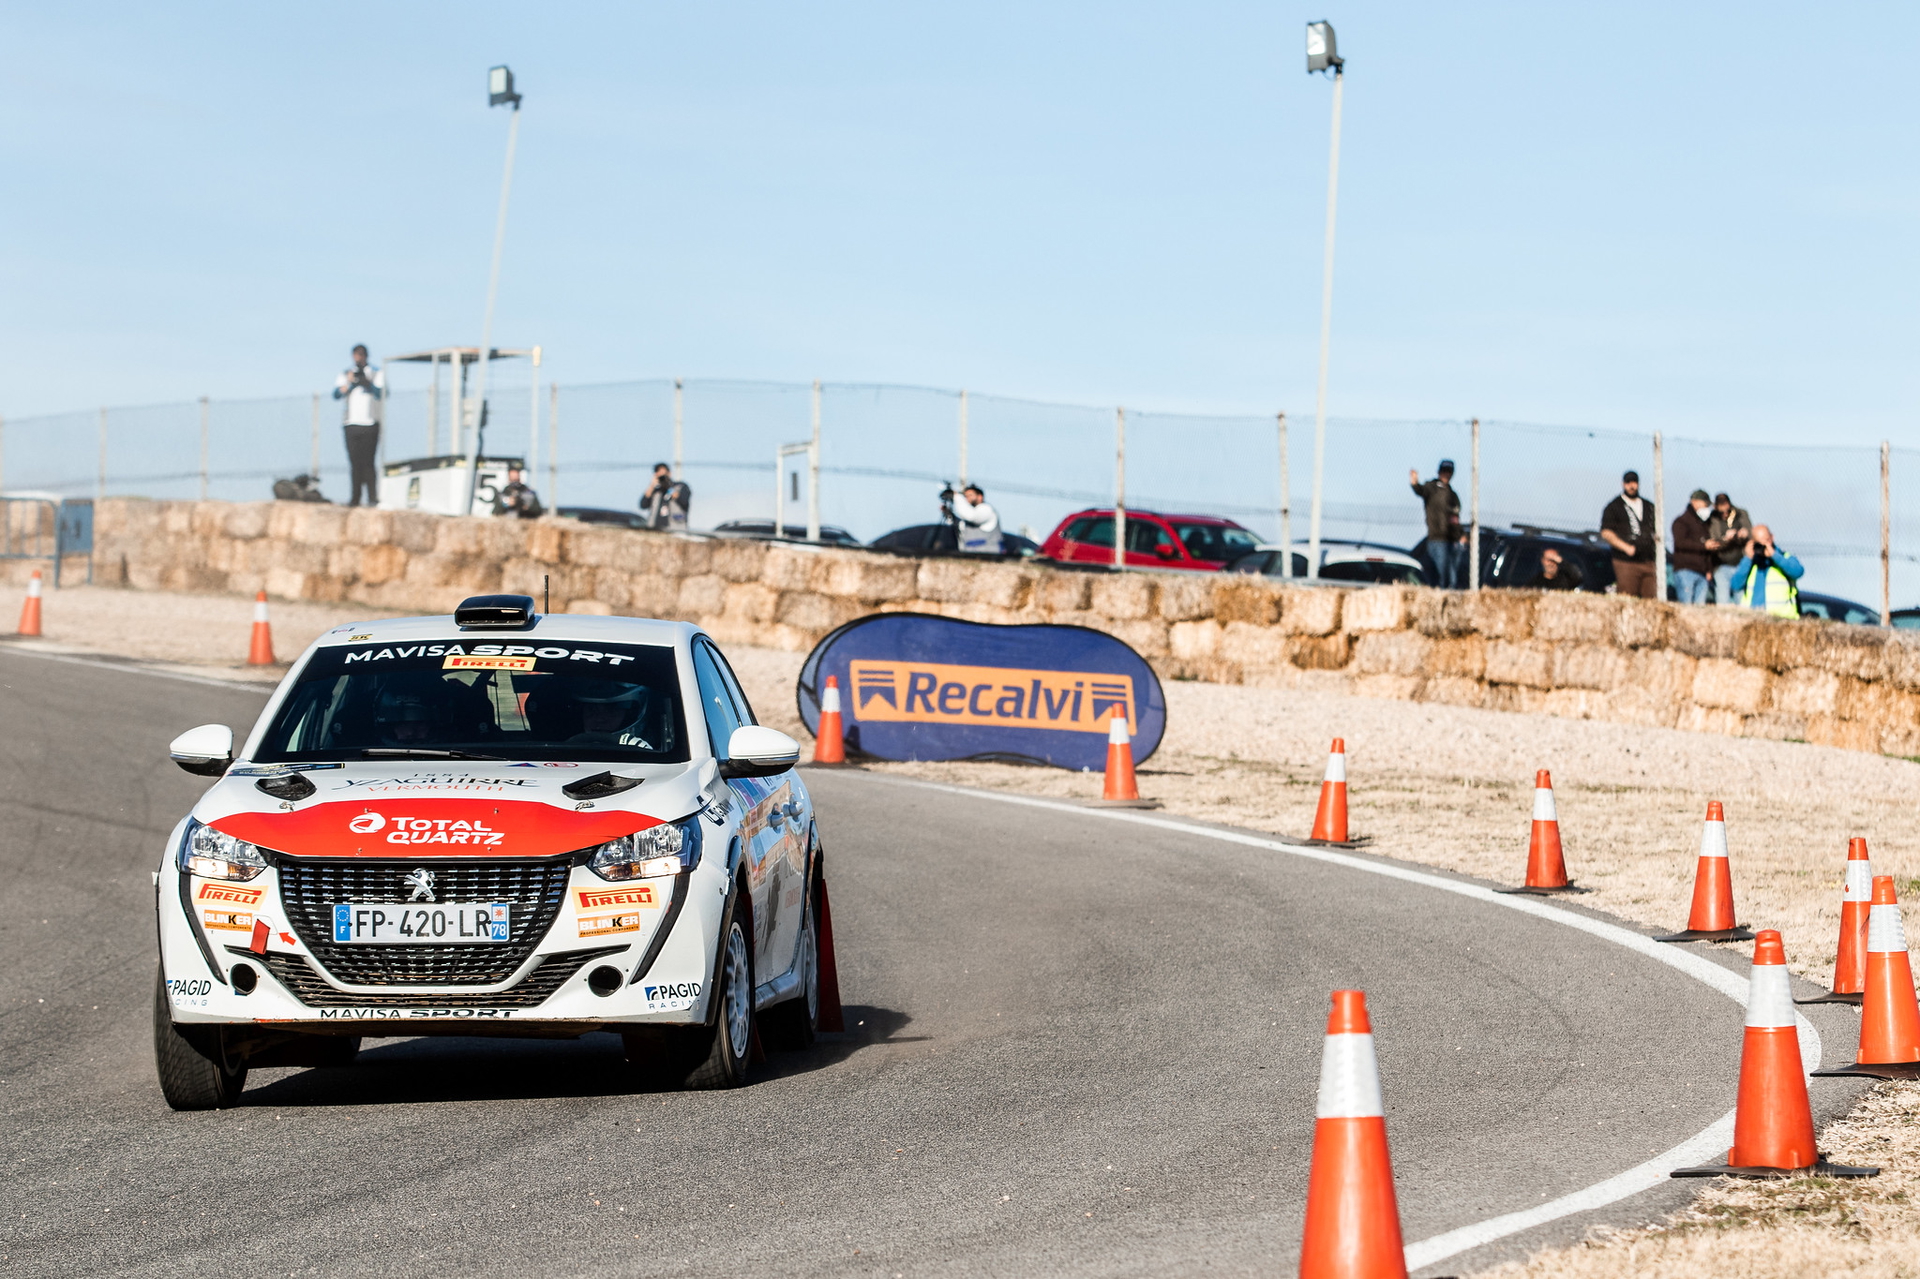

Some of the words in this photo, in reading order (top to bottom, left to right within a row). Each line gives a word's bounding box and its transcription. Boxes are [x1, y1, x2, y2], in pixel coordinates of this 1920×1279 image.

[478, 474, 498, 503] 5
[344, 644, 466, 664] MAVISA
[469, 644, 635, 666] SPORT
[452, 658, 527, 668] PIRELLI
[904, 671, 1084, 722] Recalvi
[391, 816, 492, 832] TOTAL
[386, 831, 505, 845] QUARTZ
[198, 883, 262, 905] PIRELLI
[578, 887, 653, 908] PIRELLI
[204, 912, 252, 926] BLINKER
[355, 909, 490, 938] FP-420-LR
[579, 916, 639, 930] BLINKER
[340, 925, 346, 934] F
[492, 923, 507, 937] 78
[172, 979, 212, 996] PAGID
[659, 982, 702, 1000] PAGID
[174, 998, 208, 1007] CING
[320, 1008, 401, 1020] MAVISA
[409, 1008, 519, 1019] SPORT
